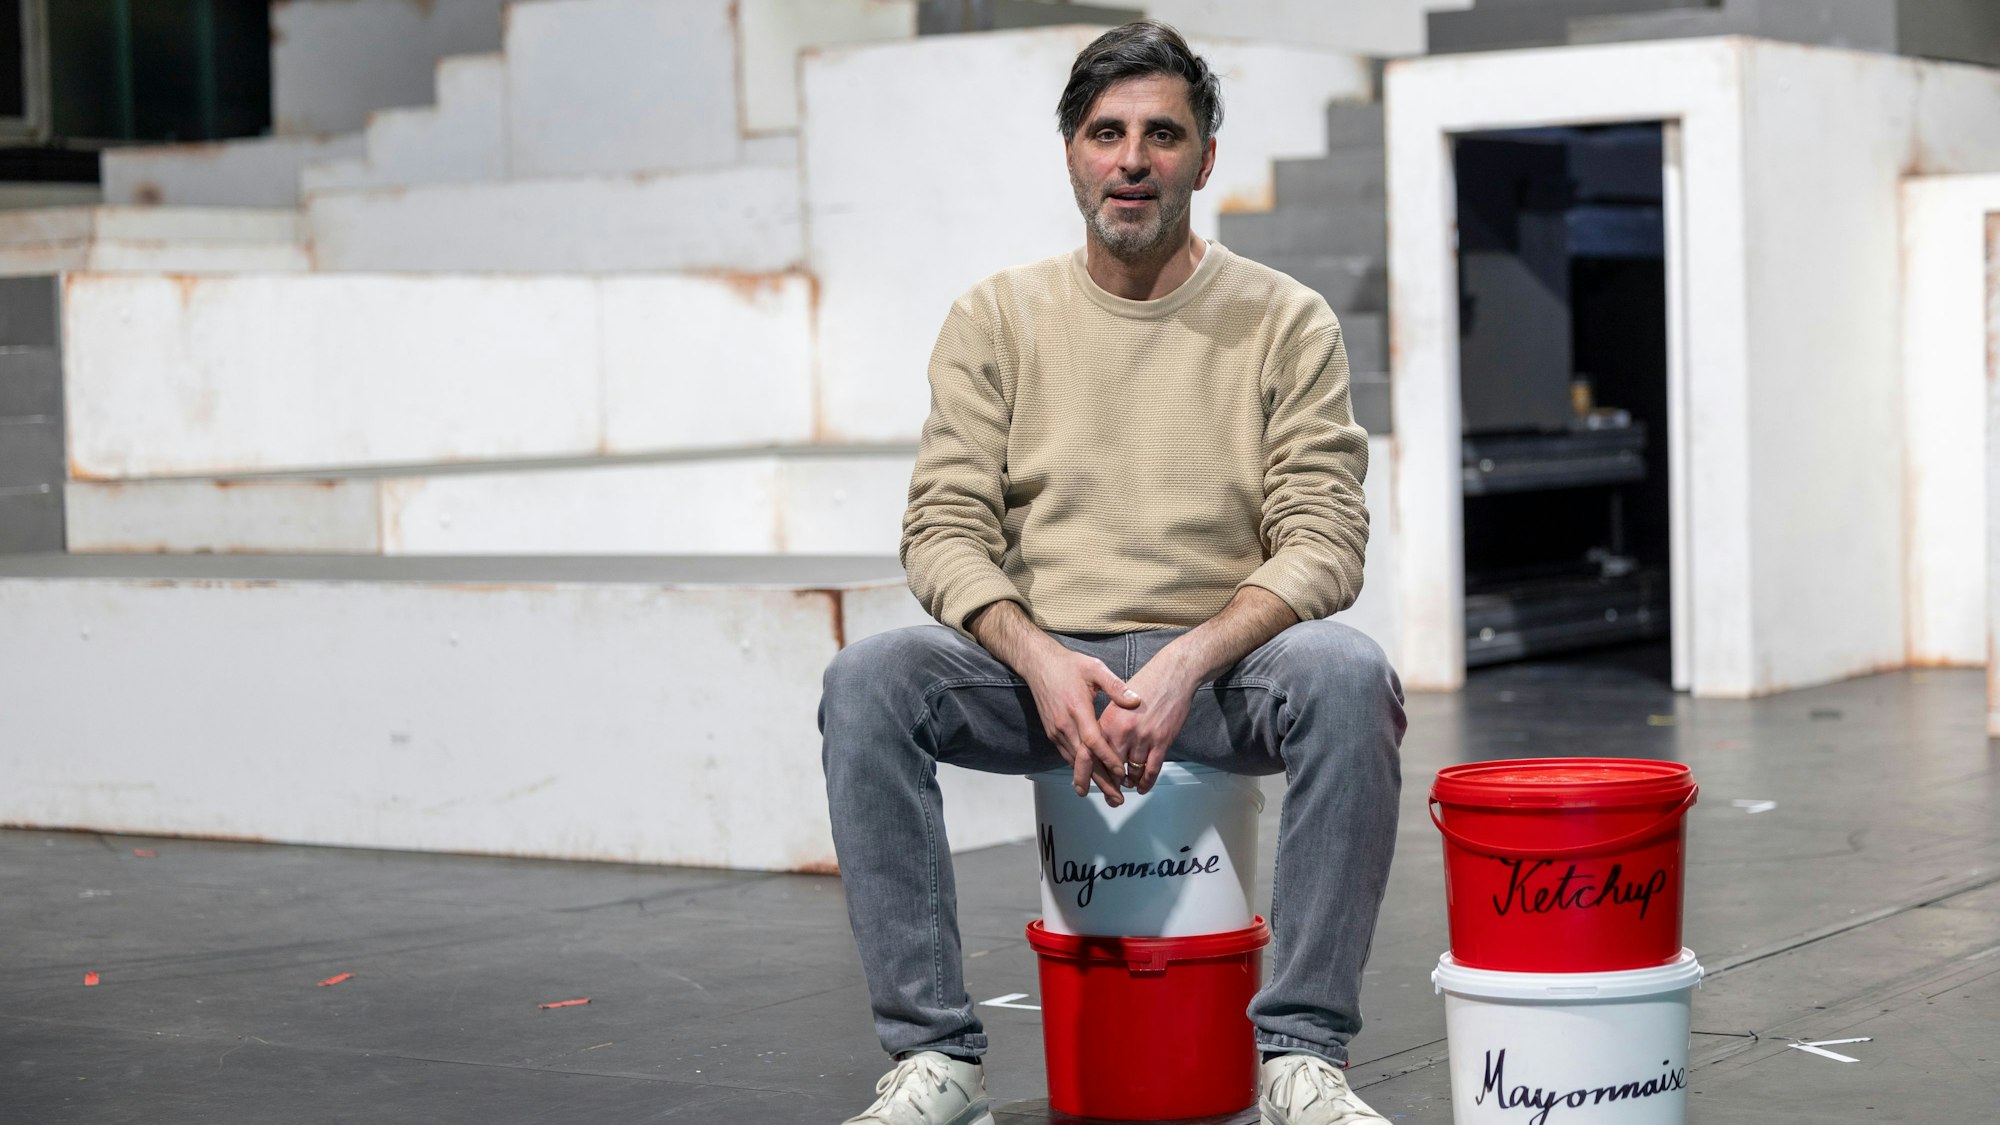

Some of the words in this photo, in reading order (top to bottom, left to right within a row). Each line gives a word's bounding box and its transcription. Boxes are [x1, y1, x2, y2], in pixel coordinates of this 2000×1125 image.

[1040, 822, 1221, 908] Mayonnaise
[1489, 855, 1667, 920] Ketchup
[1476, 1048, 1688, 1125] Mayonnaise
